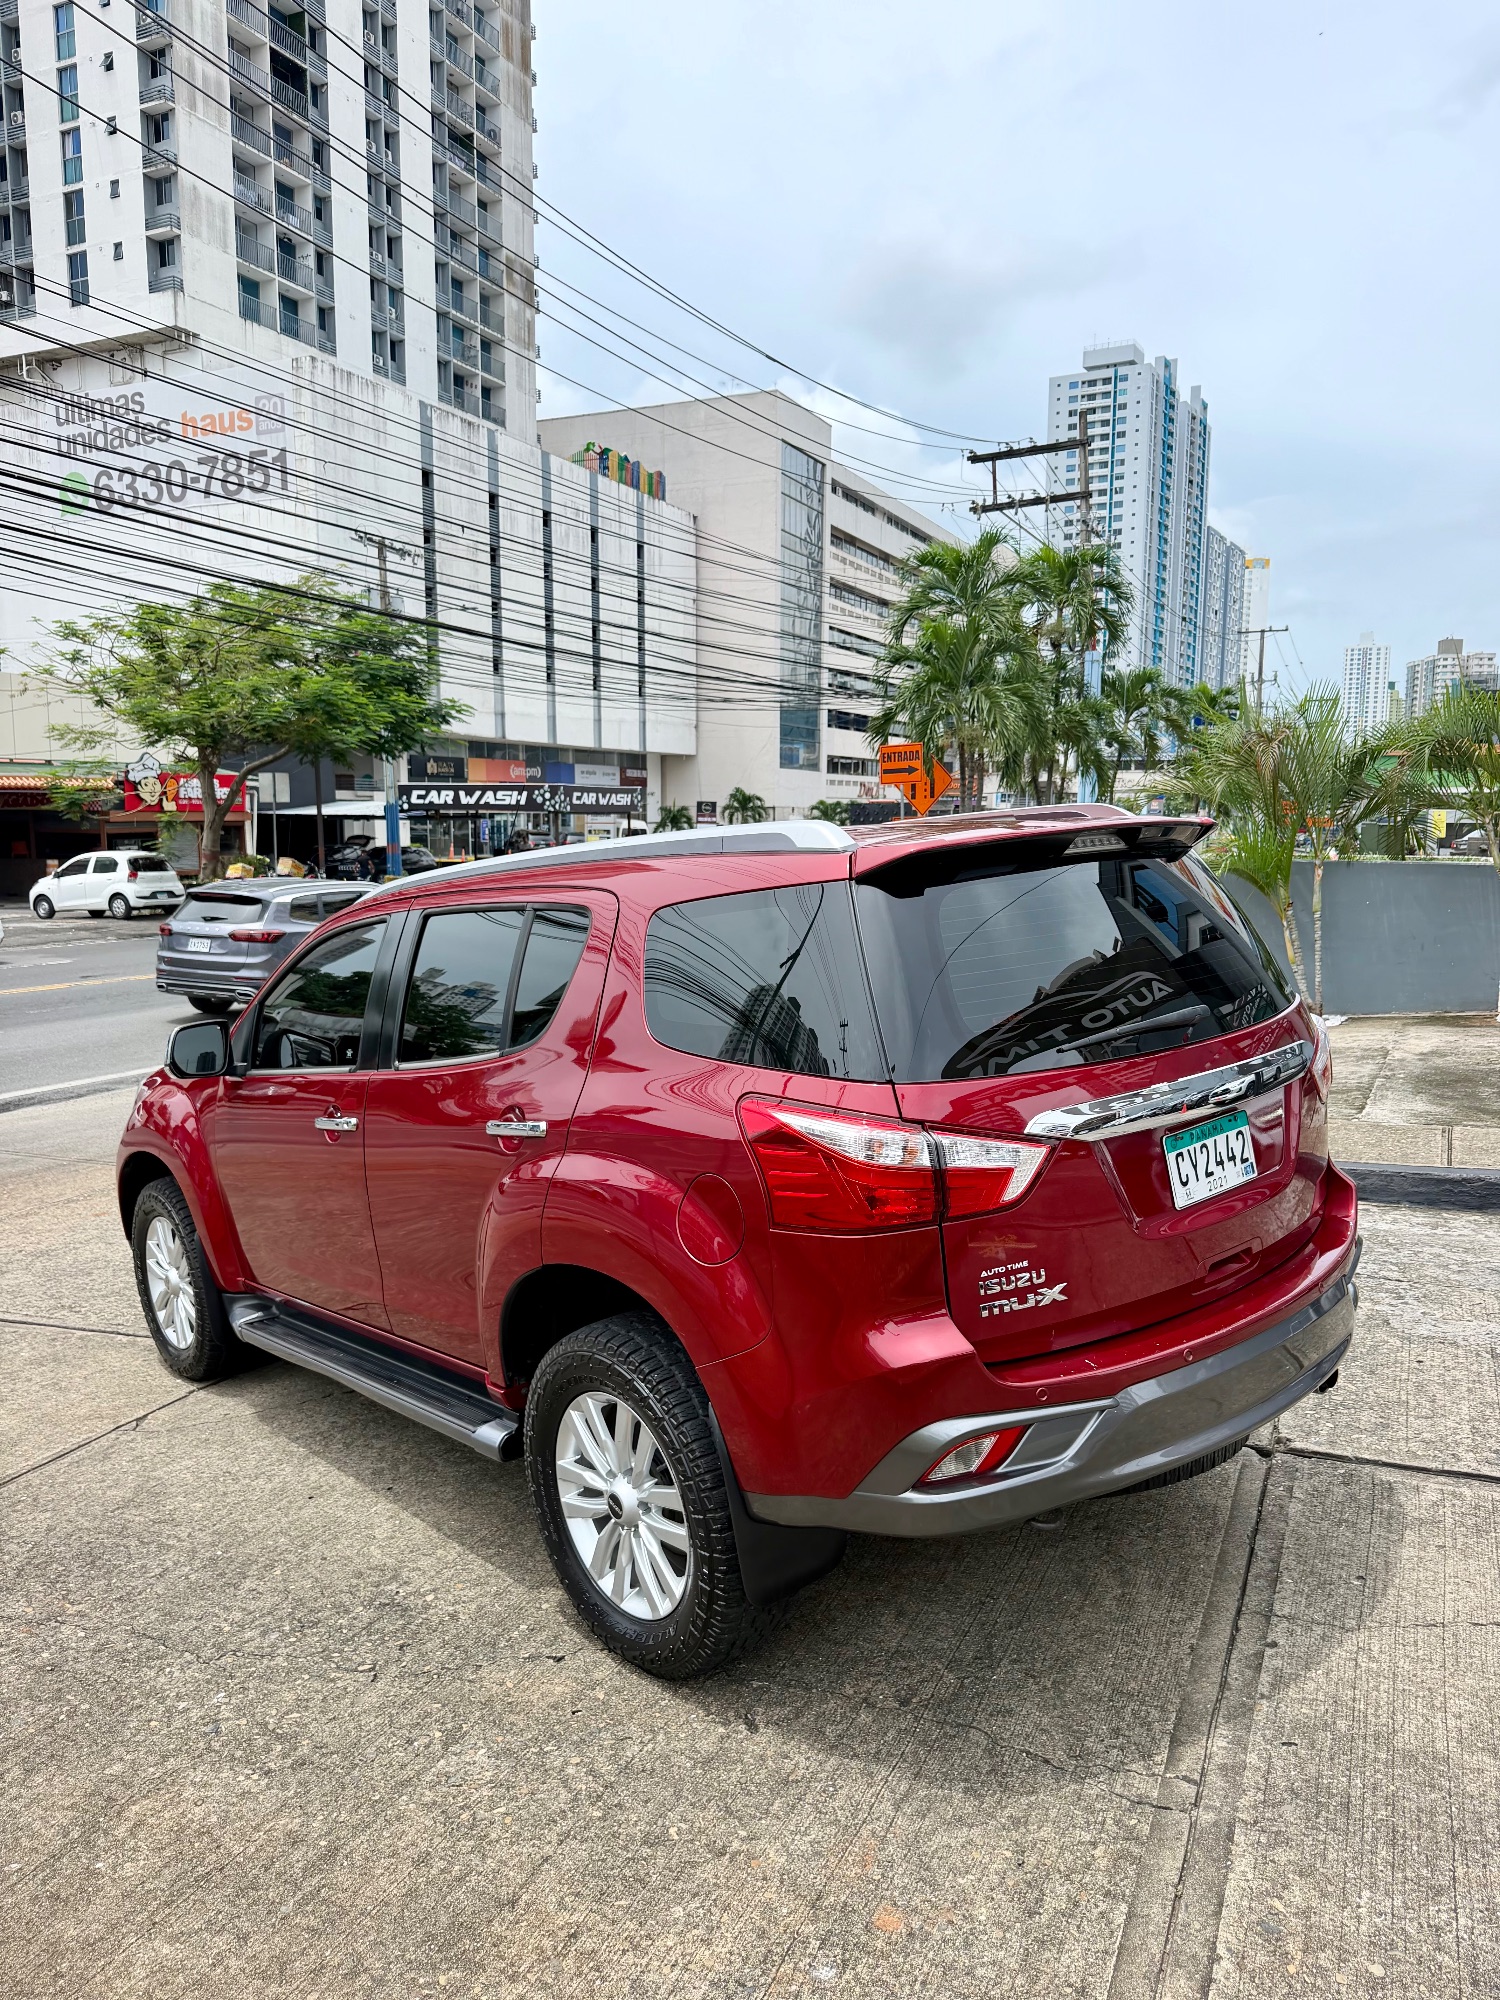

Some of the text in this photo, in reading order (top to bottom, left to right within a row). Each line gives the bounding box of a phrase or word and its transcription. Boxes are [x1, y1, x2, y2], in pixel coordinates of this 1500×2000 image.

[259, 397, 281, 417] 20
[181, 410, 254, 438] haus
[57, 417, 171, 455] unidades
[94, 447, 288, 512] 6330-7851
[882, 750, 920, 763] ENTRADA
[410, 790, 527, 805] CAR WASH
[572, 792, 631, 806] CAR WASH
[1190, 1123, 1224, 1141] PANAMA
[1175, 1130, 1249, 1187] CY2442
[1207, 1175, 1228, 1192] 2021
[981, 1260, 1028, 1277] AUTO TIME
[979, 1269, 1045, 1295] ISUZU
